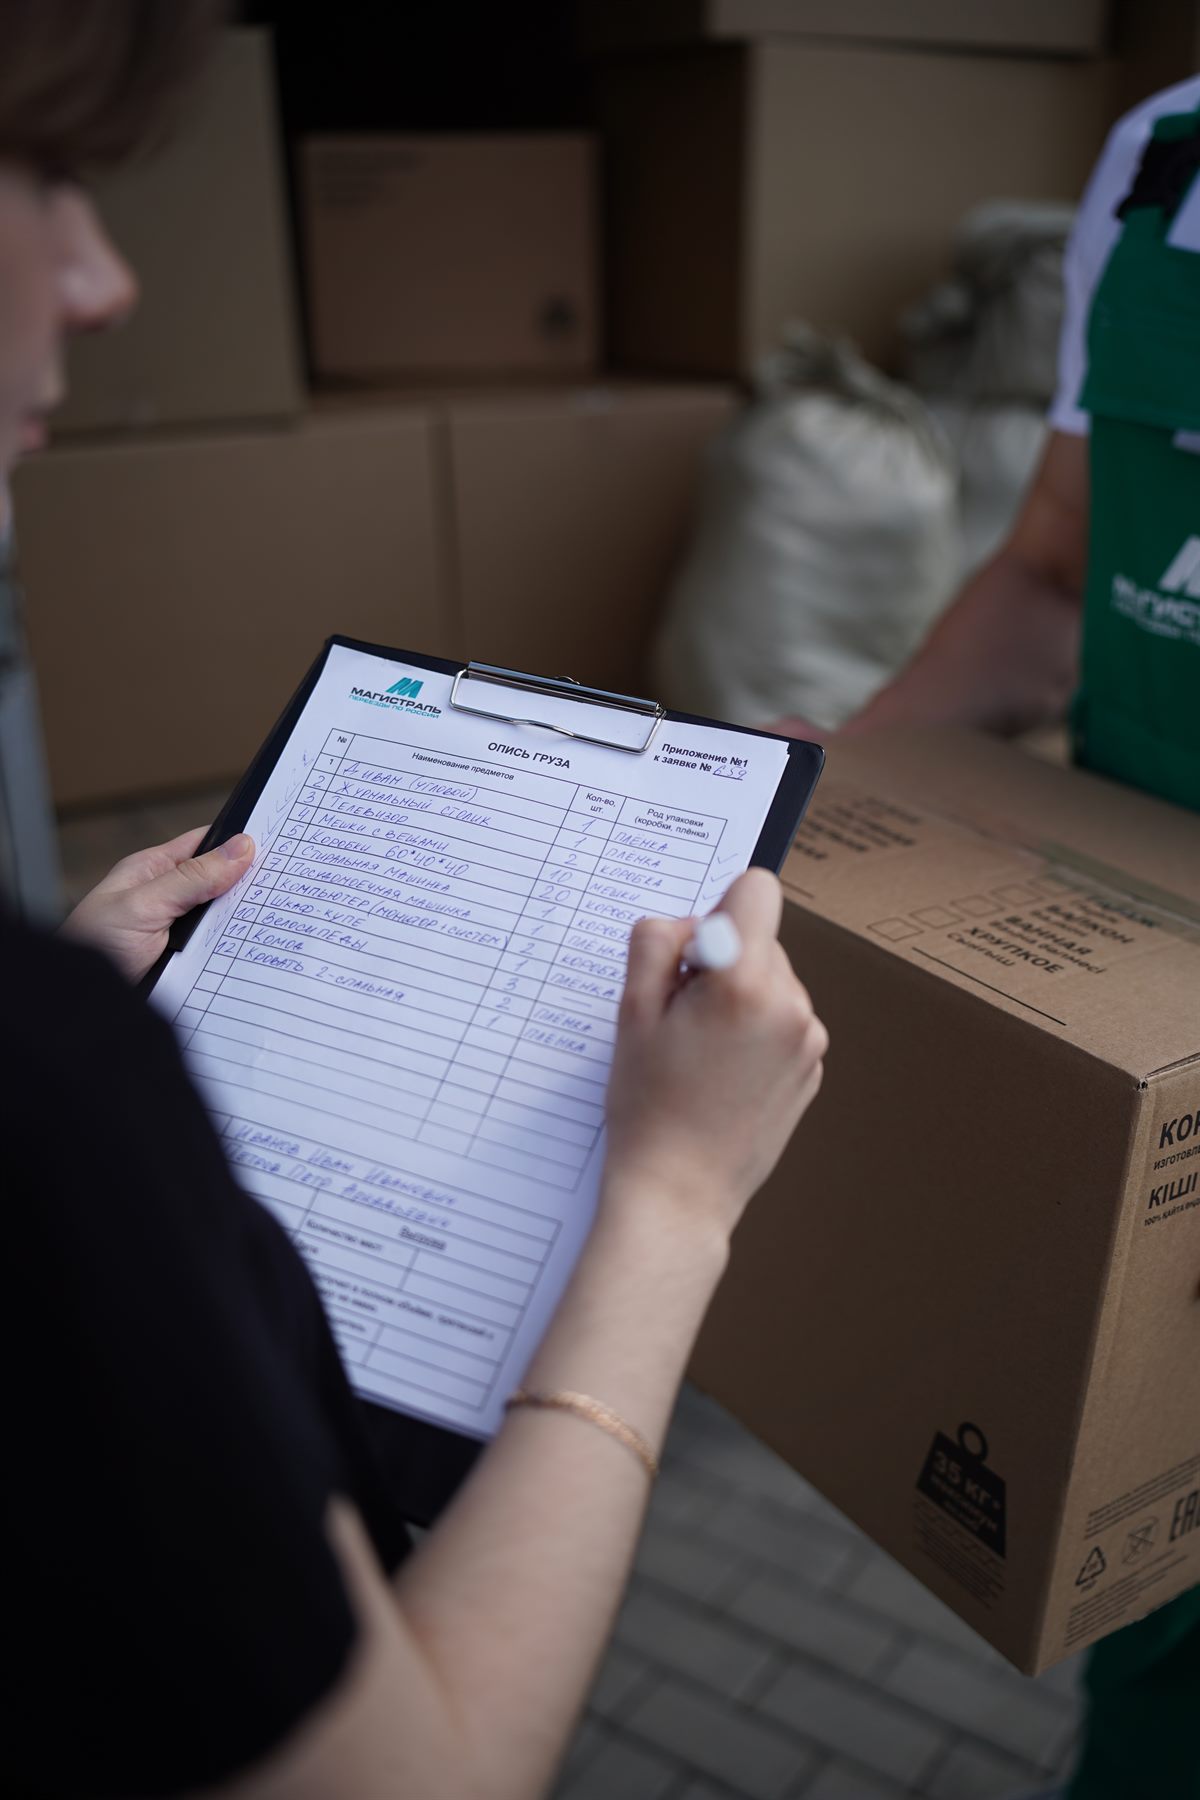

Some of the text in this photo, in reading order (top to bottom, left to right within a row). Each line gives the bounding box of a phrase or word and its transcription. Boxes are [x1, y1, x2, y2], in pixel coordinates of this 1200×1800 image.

[350, 686, 442, 715] МАГИСТРАЛЬ
[392, 704, 404, 712] ПО
[336, 734, 348, 744] №
[487, 741, 571, 769] ОПИСЬ ГРУЗА
[661, 743, 748, 768] Приложение №1
[412, 752, 514, 781] Наименование предметов
[661, 756, 697, 769] заявке
[699, 762, 712, 772] №
[312, 775, 326, 788] 2
[303, 791, 316, 804] 3
[585, 792, 616, 807] Кол-во,
[297, 808, 310, 821] 4
[590, 804, 604, 813] шт.
[647, 808, 704, 828] Род упаковки
[287, 824, 304, 837] 5
[581, 818, 597, 833] 1
[634, 816, 710, 840] (коробки, плёнка)
[278, 840, 293, 853] 6
[574, 837, 588, 848] 1
[269, 857, 283, 869] 7
[564, 853, 577, 866] 2
[256, 873, 271, 886] 8
[549, 868, 573, 884] 10
[249, 889, 263, 901] 9
[539, 885, 571, 902] 20
[236, 907, 256, 920] 10
[541, 906, 556, 919] 1
[228, 924, 248, 937] 11
[530, 924, 544, 936] 1
[217, 940, 237, 955] 12
[519, 942, 535, 955] 2
[966, 925, 1066, 975] ХРУПКОЕ
[514, 959, 529, 972] 1
[503, 976, 519, 991] 3
[496, 995, 512, 1011] 2
[486, 1015, 501, 1028] 1
